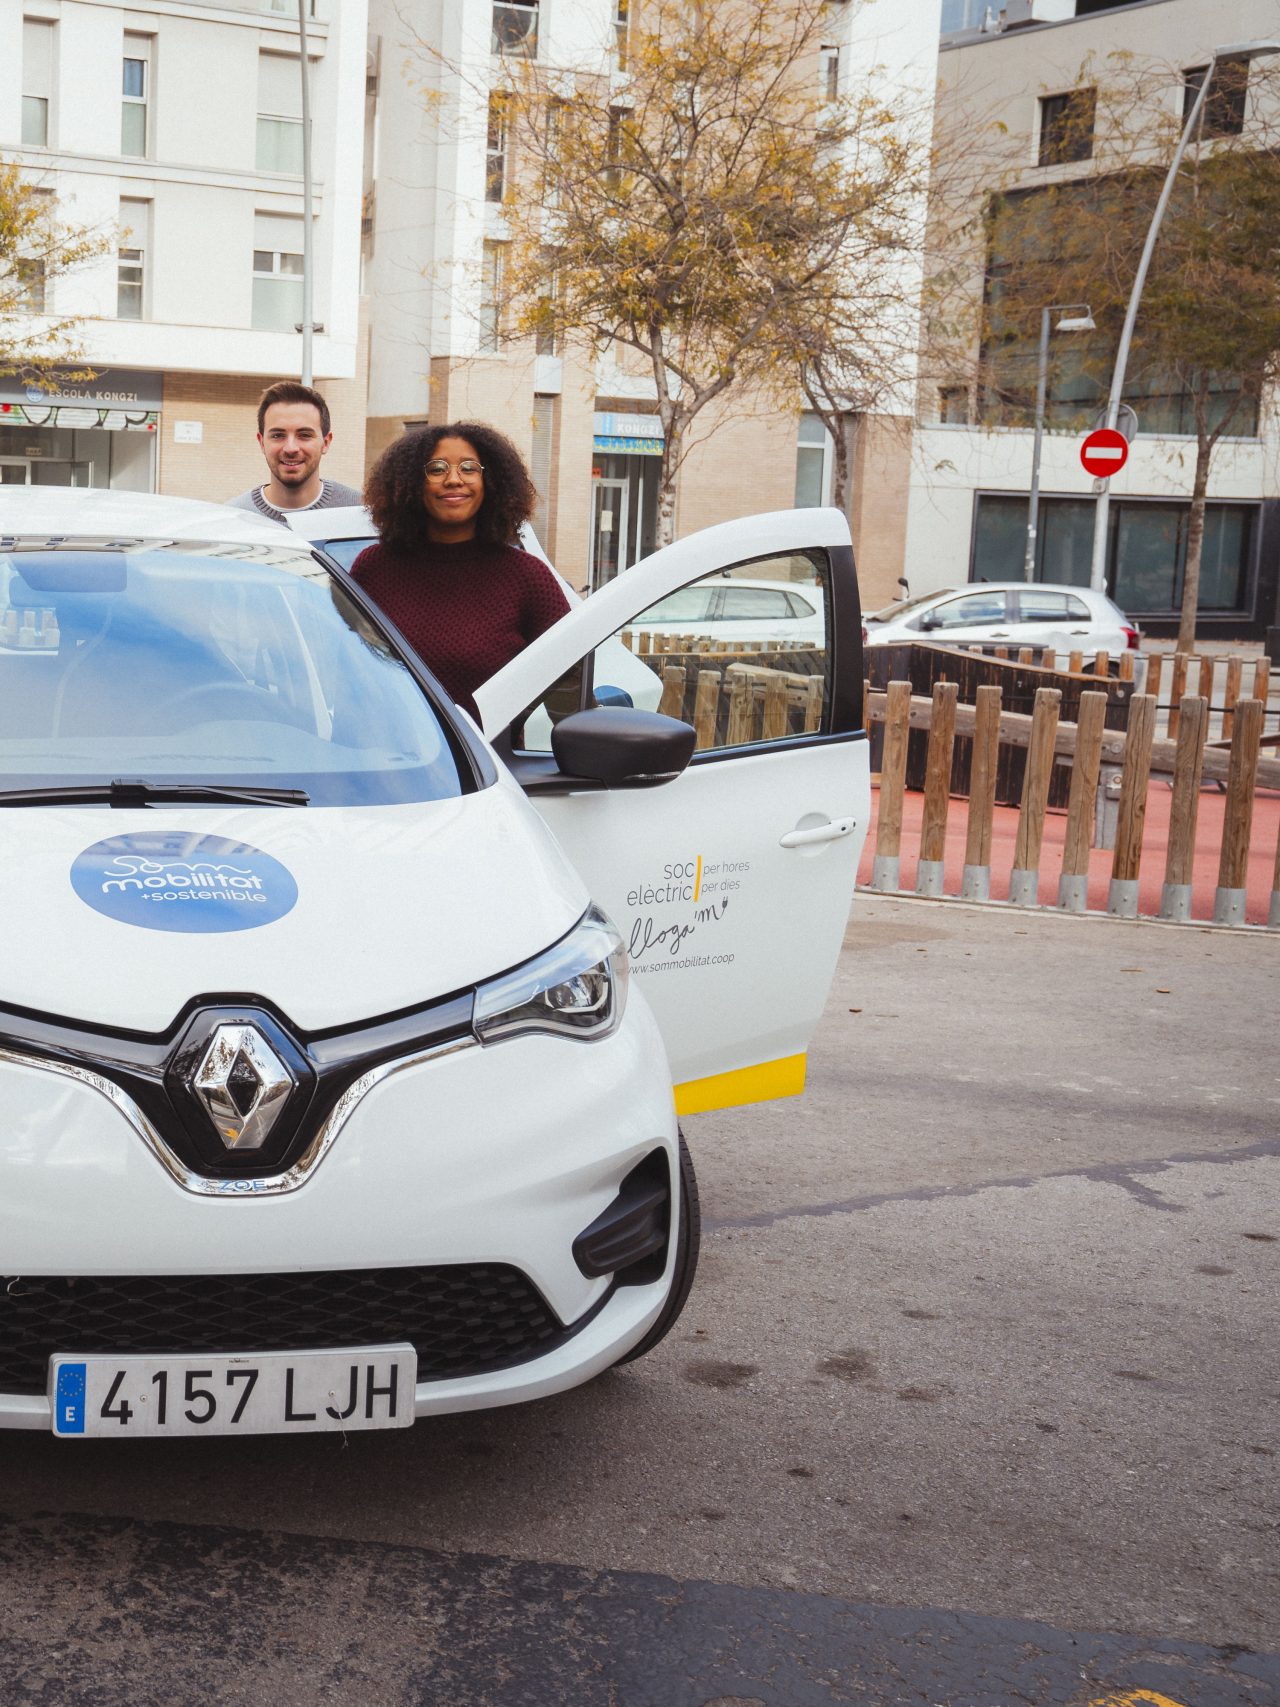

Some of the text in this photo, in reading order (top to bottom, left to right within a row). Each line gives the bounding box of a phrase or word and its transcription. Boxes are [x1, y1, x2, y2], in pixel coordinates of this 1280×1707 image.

[48, 388, 138, 402] ESCOLA KONGZI
[104, 855, 252, 877] Som
[703, 861, 750, 876] per hores
[101, 873, 263, 893] mobilitat
[701, 879, 741, 894] per dies
[627, 881, 693, 906] elèctric
[628, 953, 735, 975] ww.sommobilitat.coop
[100, 1363, 398, 1425] 4157 LJH
[65, 1406, 76, 1422] E
